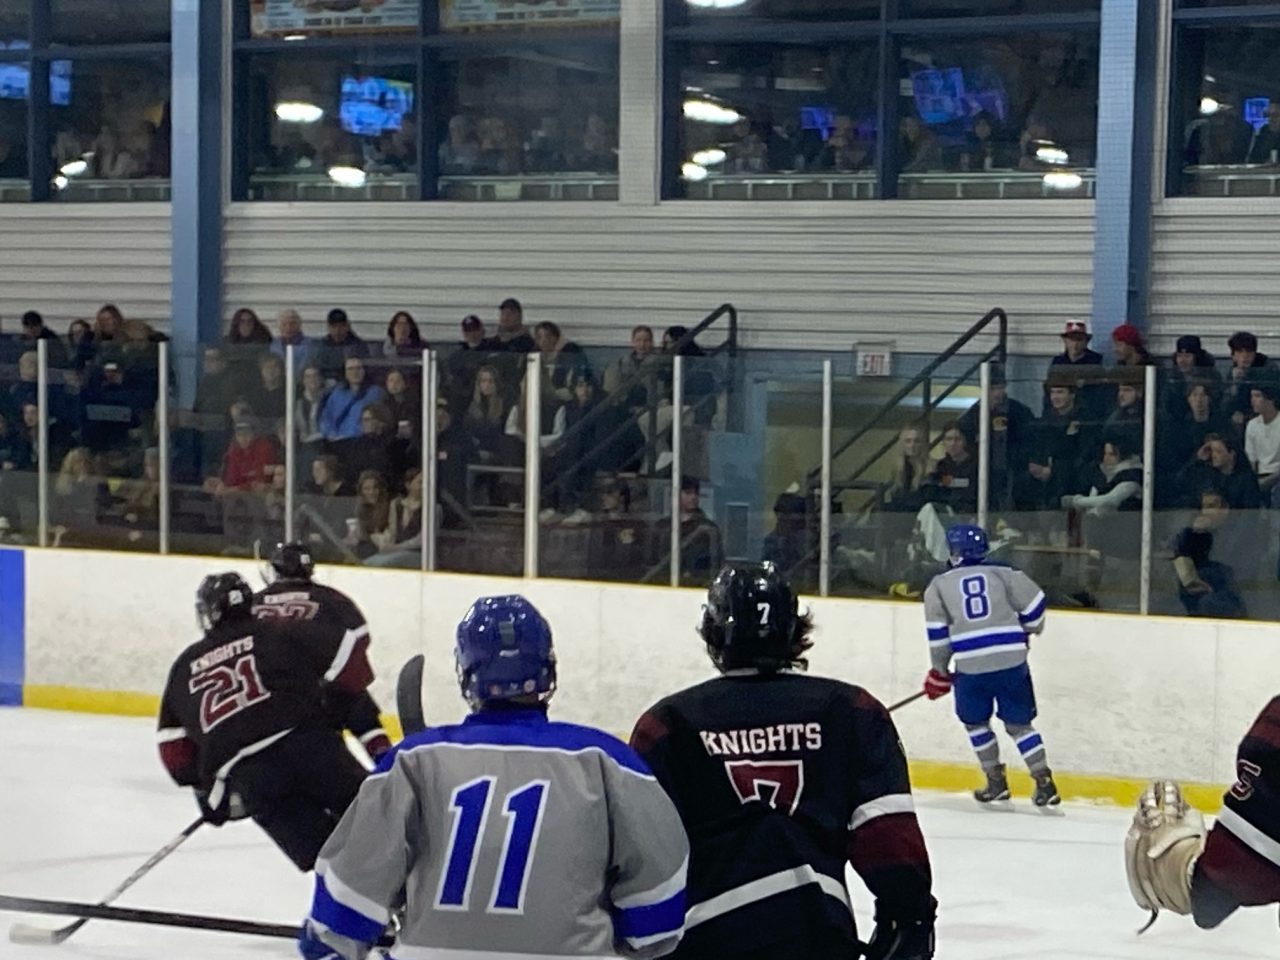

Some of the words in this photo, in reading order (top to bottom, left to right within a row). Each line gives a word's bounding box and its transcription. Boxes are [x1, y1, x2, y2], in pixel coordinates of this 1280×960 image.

[757, 602, 770, 625] 7
[960, 573, 991, 621] 8
[190, 635, 254, 675] KNIGHTS
[189, 654, 271, 733] 21
[699, 722, 821, 756] KNIGHTS
[433, 775, 551, 915] 11
